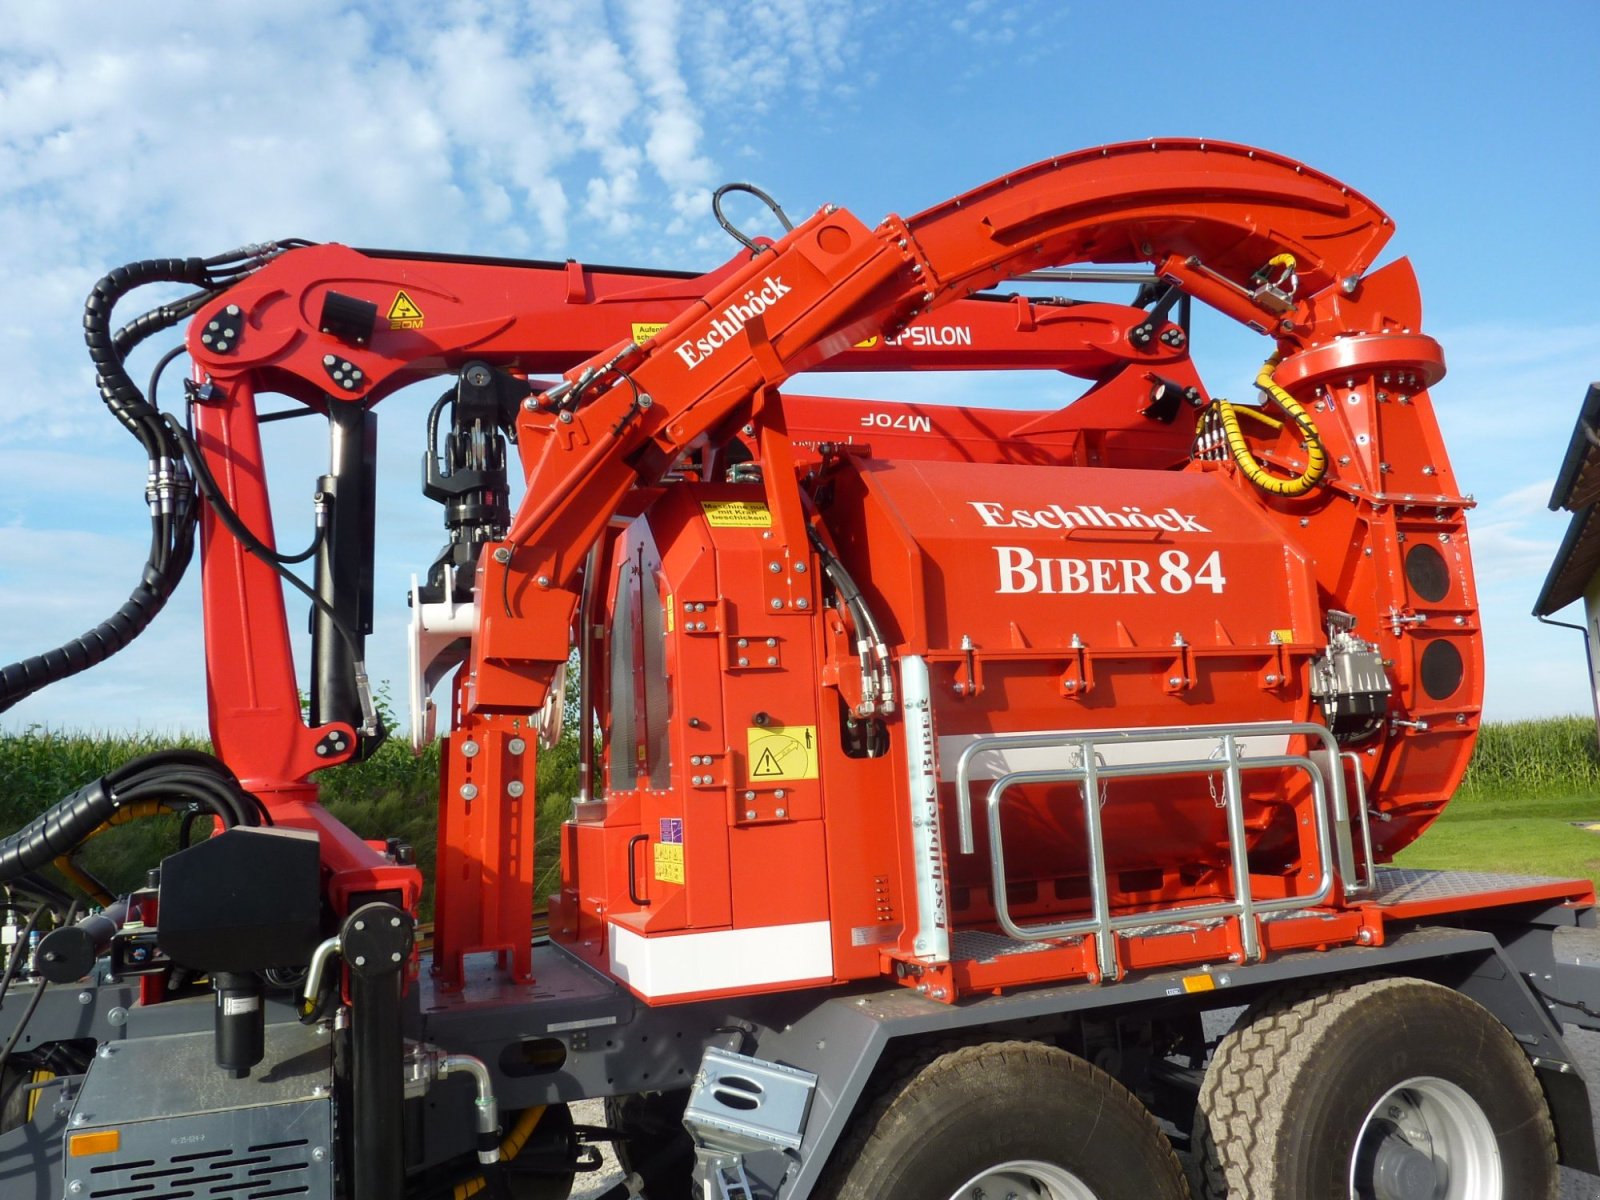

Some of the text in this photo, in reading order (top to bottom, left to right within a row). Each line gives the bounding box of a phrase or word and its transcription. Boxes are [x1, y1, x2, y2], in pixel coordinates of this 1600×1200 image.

[674, 276, 792, 371] Eschlböck
[967, 501, 1213, 533] Eschlböck
[1158, 550, 1227, 594] 84
